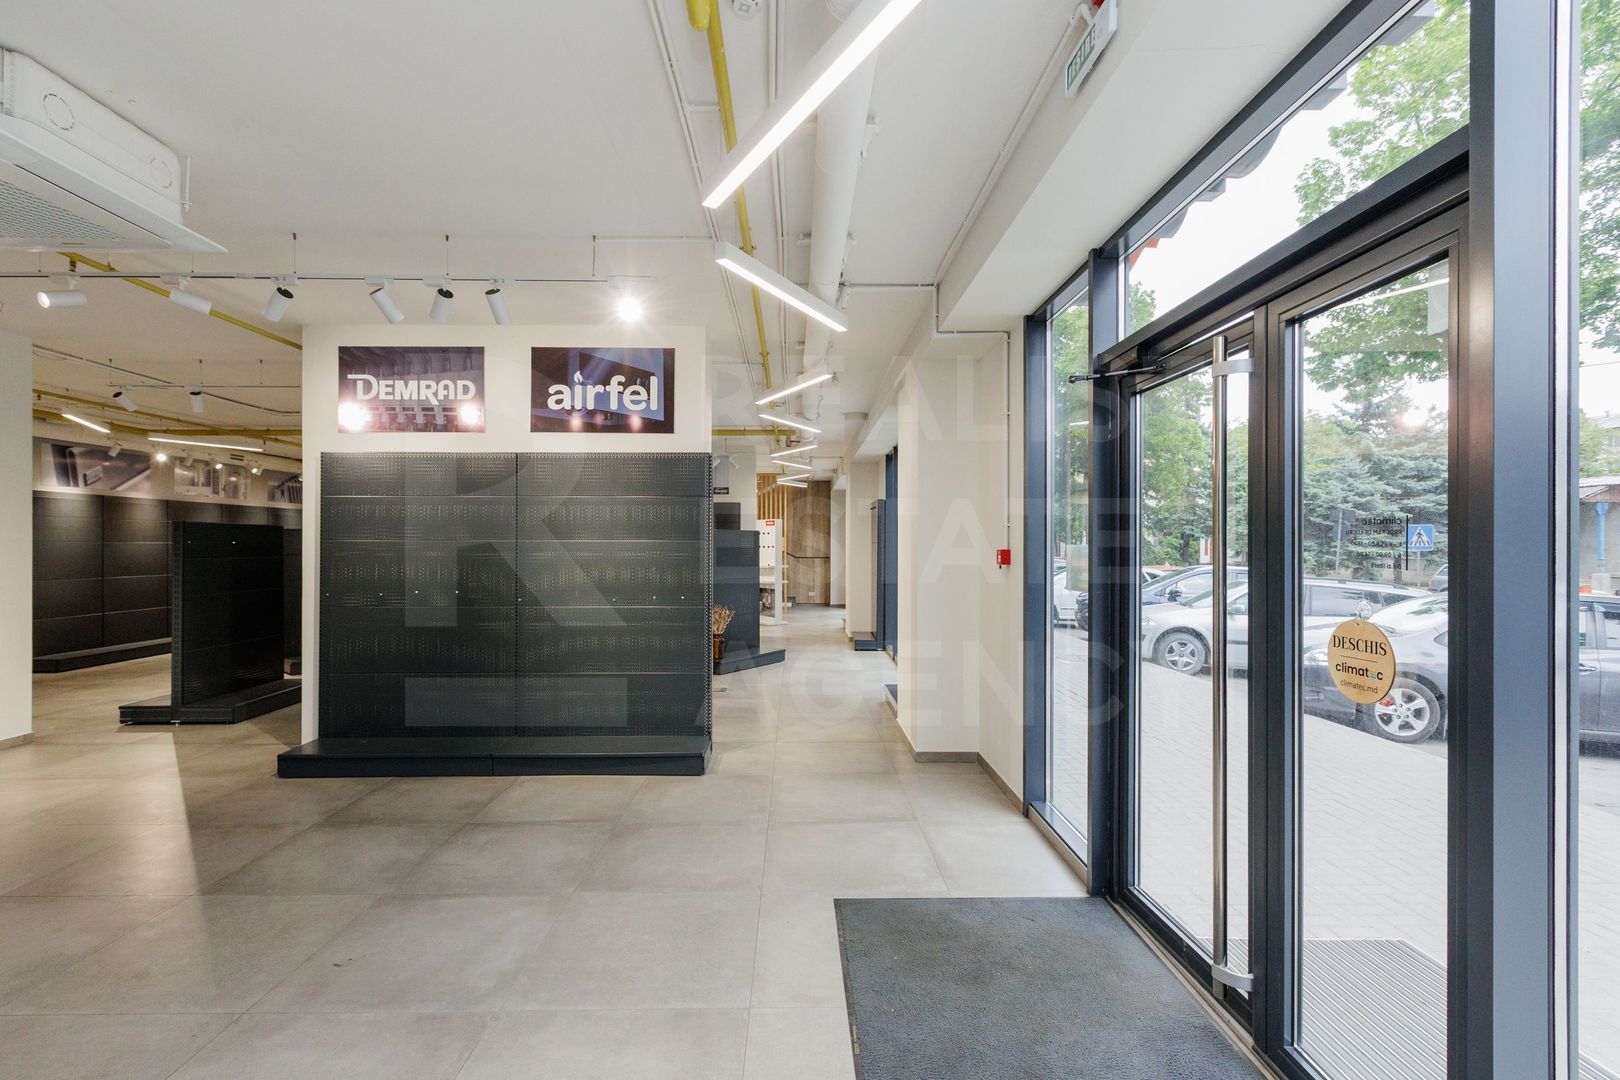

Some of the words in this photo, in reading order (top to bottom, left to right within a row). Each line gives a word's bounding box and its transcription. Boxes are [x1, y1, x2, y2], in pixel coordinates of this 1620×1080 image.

[347, 374, 476, 405] DEMRAD
[547, 370, 658, 411] airfel
[1333, 635, 1387, 656] DESCHIS
